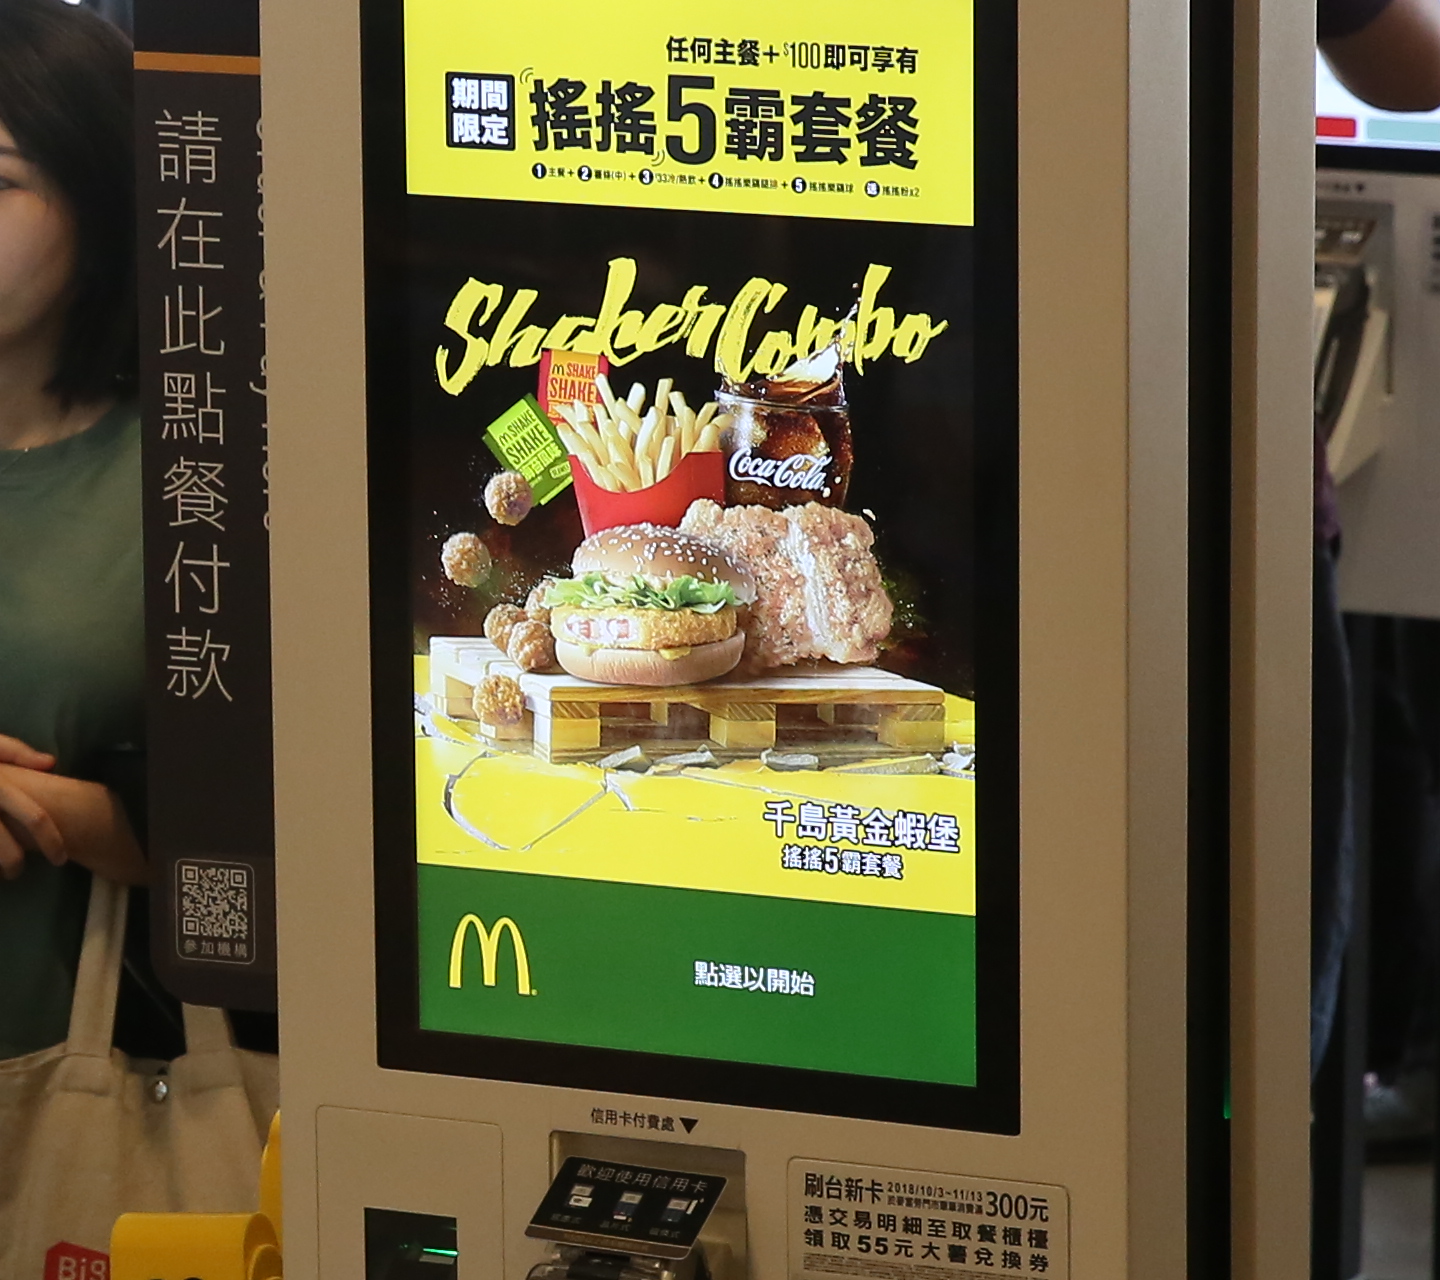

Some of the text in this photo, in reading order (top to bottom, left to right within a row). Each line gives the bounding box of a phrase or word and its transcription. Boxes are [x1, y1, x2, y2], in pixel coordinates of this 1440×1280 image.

[451, 77, 508, 111] 期間
[452, 112, 510, 146] 限定
[528, 74, 920, 170] 搖搖5霸套餐
[566, 362, 597, 378] SHAKE
[154, 108, 233, 703] 請在此點餐付款
[549, 377, 599, 404] SHAKE
[507, 409, 537, 439] SHAKE
[505, 423, 553, 465] SHAKE
[729, 447, 833, 490] Coca-Cola
[763, 800, 960, 853] 千島黃金蝦堡
[781, 844, 903, 879] 搖搖5霸套餐
[693, 959, 816, 998] 點選以開始
[591, 1107, 676, 1132] 信用卡付費處
[577, 1163, 709, 1194] 歡迎使用信用卡
[804, 1172, 884, 1204] 刷台新卡
[985, 1191, 1049, 1222] 300元
